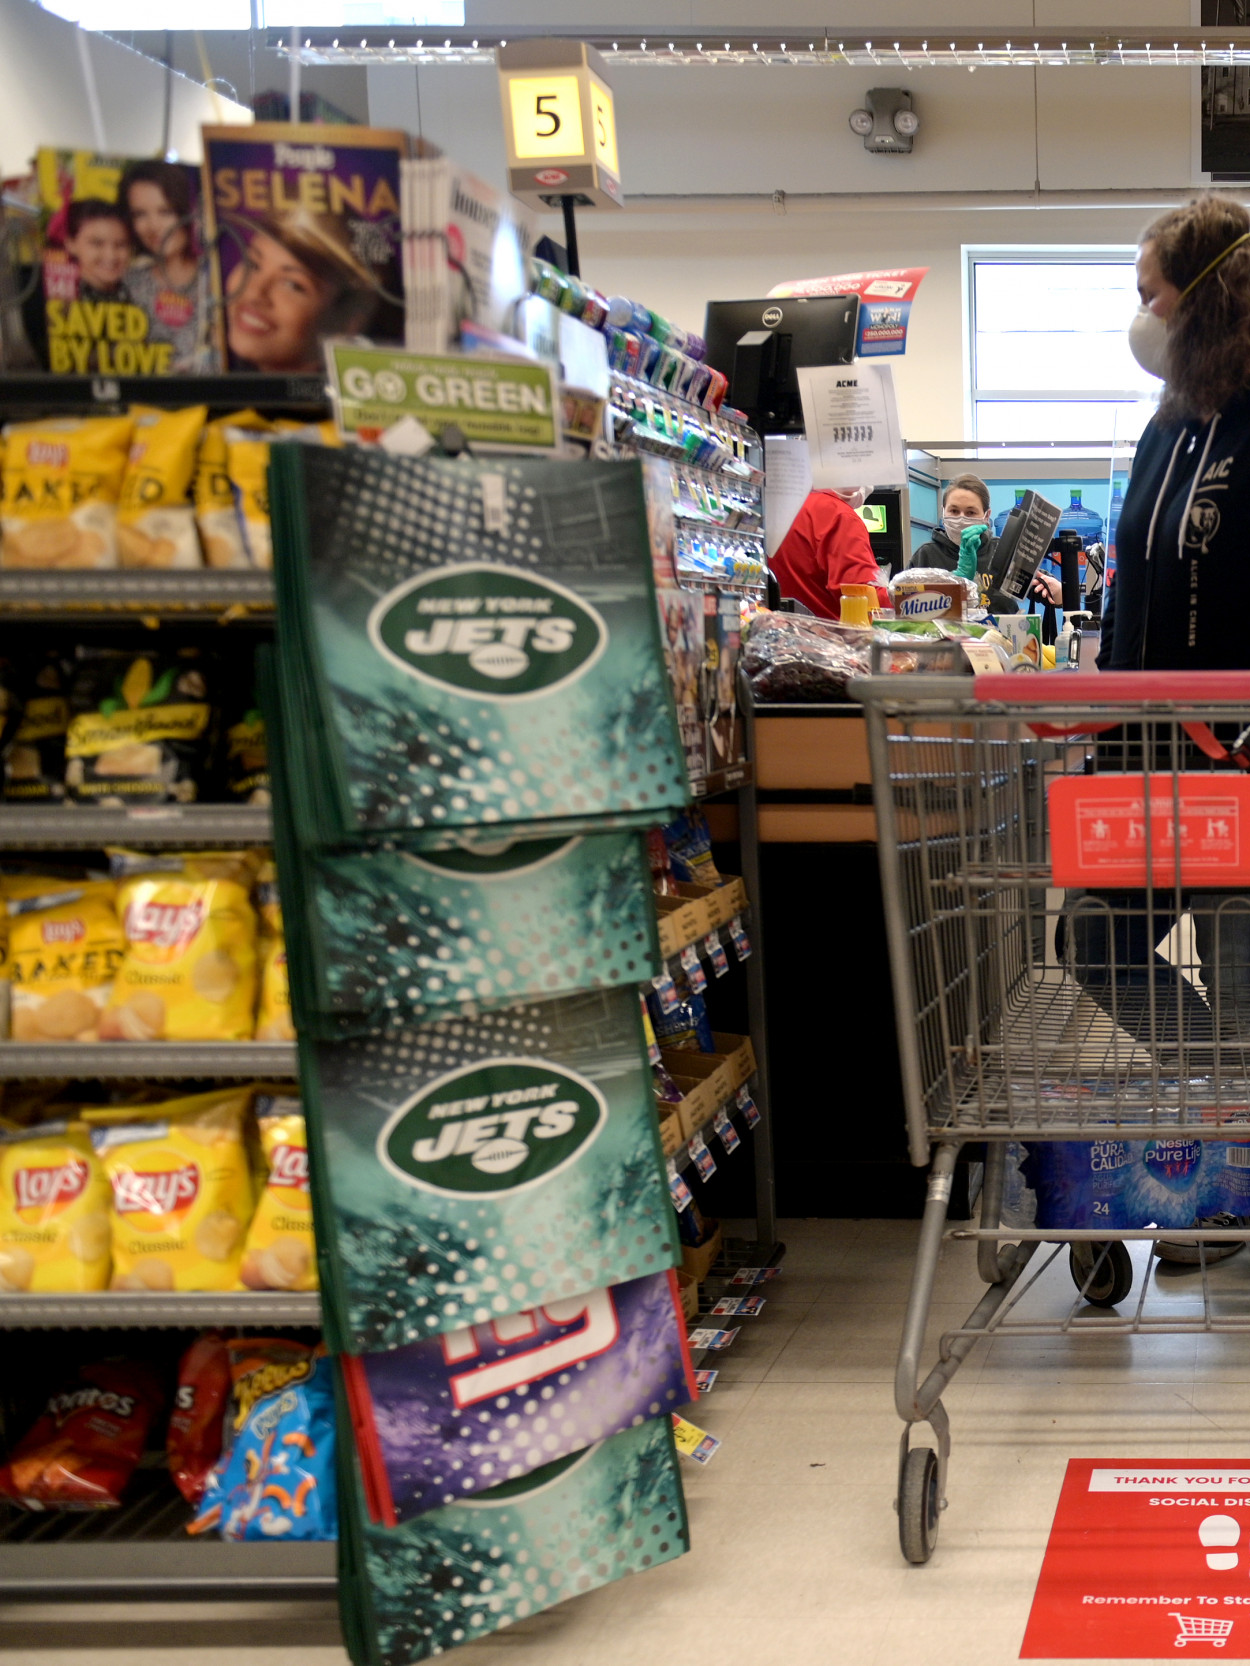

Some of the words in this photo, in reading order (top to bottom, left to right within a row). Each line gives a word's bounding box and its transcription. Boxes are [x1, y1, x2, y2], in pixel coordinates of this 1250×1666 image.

[536, 95, 561, 137] 5
[215, 168, 399, 216] SELENA
[46, 299, 148, 341] SAVED
[764, 313, 781, 321] DELL
[50, 338, 92, 374] BY
[97, 341, 173, 377] LOVE
[415, 374, 549, 416] GREEN
[836, 379, 858, 388] ACME
[1202, 456, 1234, 482] AIC
[1190, 559, 1198, 589] ALICE
[417, 597, 483, 615] NEW
[485, 597, 555, 614] YORK
[900, 595, 952, 617] Minute
[405, 617, 576, 656] JETS
[126, 899, 204, 947] Lay's
[427, 1094, 491, 1120] NEW
[491, 1082, 561, 1109] YORK
[412, 1099, 579, 1164] JETS
[1091, 1143, 1125, 1159] PURA
[1145, 1149, 1184, 1163] Pure
[1185, 1145, 1202, 1164] Life
[112, 1163, 200, 1218] Lay's
[1093, 1200, 1111, 1216] 24
[1114, 1475, 1182, 1486] THANK
[1184, 1475, 1225, 1486] YOU
[1148, 1497, 1220, 1508] SOCIAL
[1082, 1594, 1192, 1606] Remember
[1197, 1595, 1219, 1606] To
